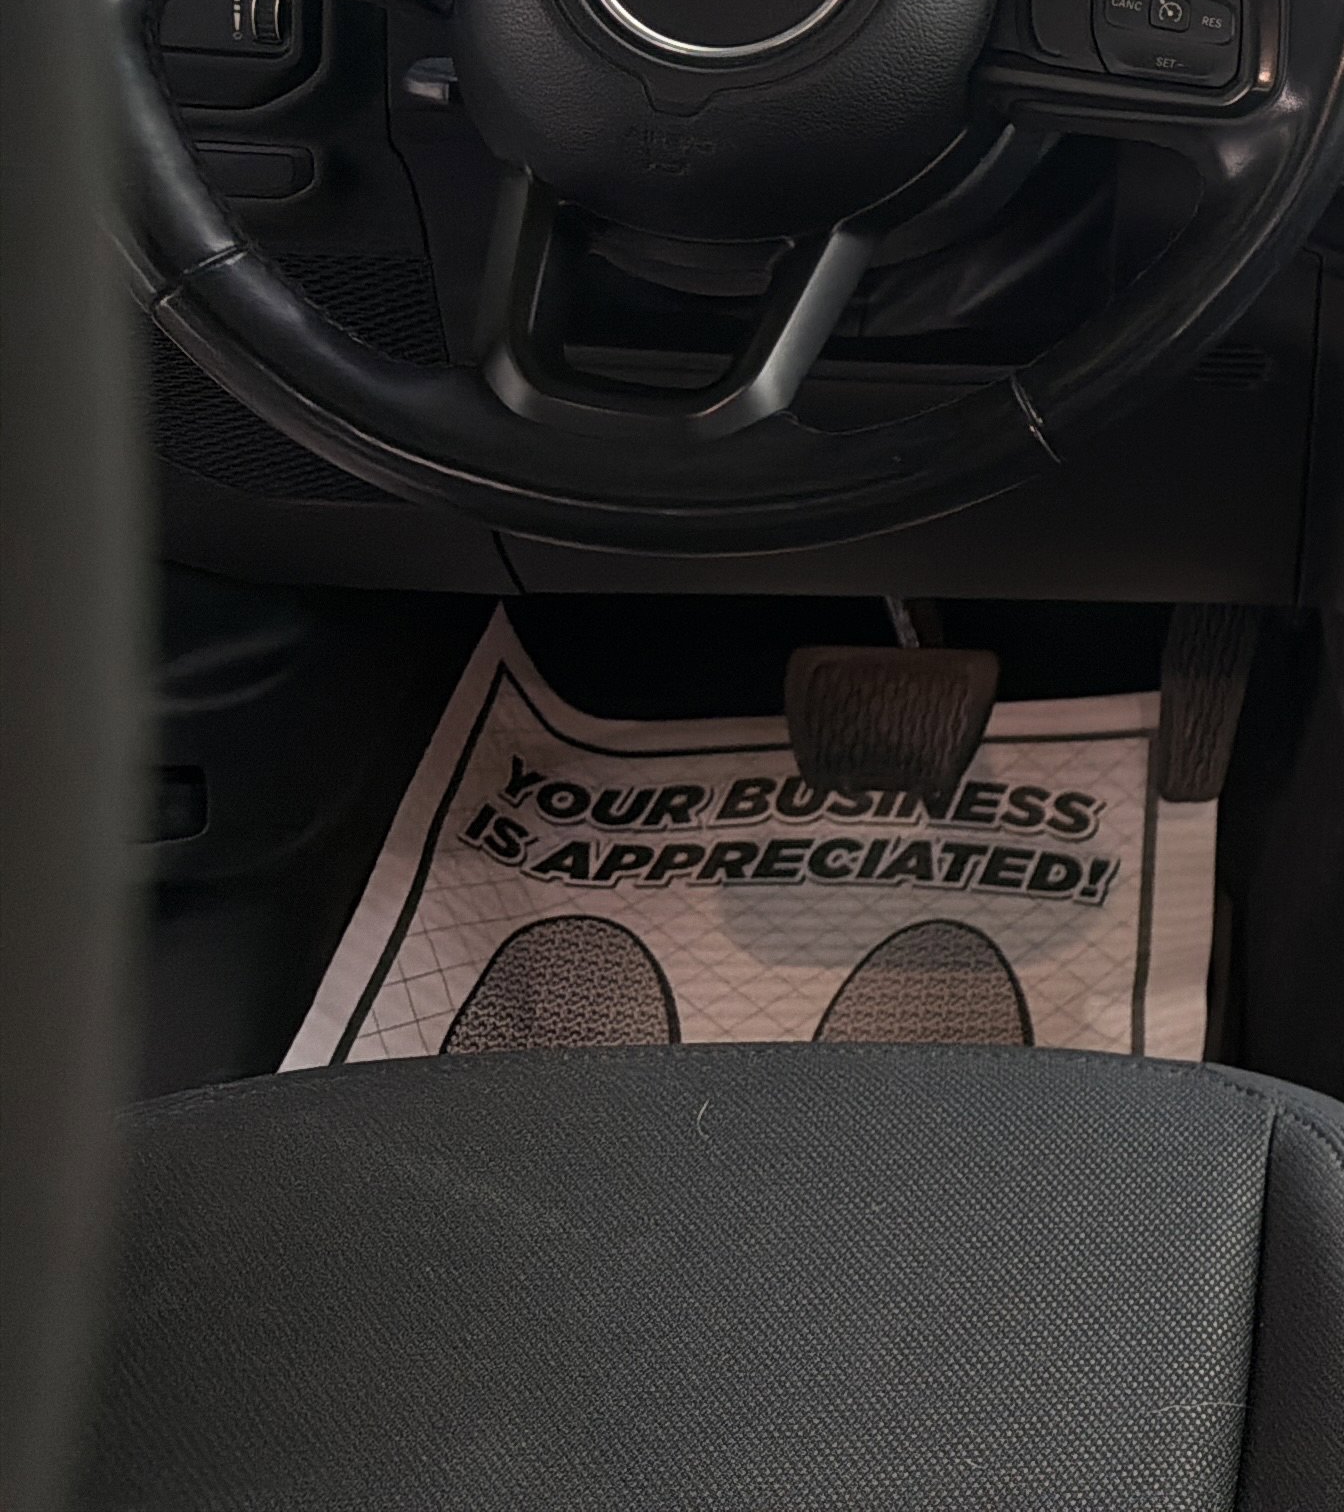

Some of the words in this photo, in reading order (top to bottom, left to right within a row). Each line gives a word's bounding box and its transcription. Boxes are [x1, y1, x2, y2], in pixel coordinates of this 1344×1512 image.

[1201, 16, 1222, 29] RES
[500, 754, 702, 827] YOUR
[717, 776, 1106, 838] BUSINESS
[459, 801, 538, 864] IS
[525, 835, 1121, 906] APPRECIATED!
